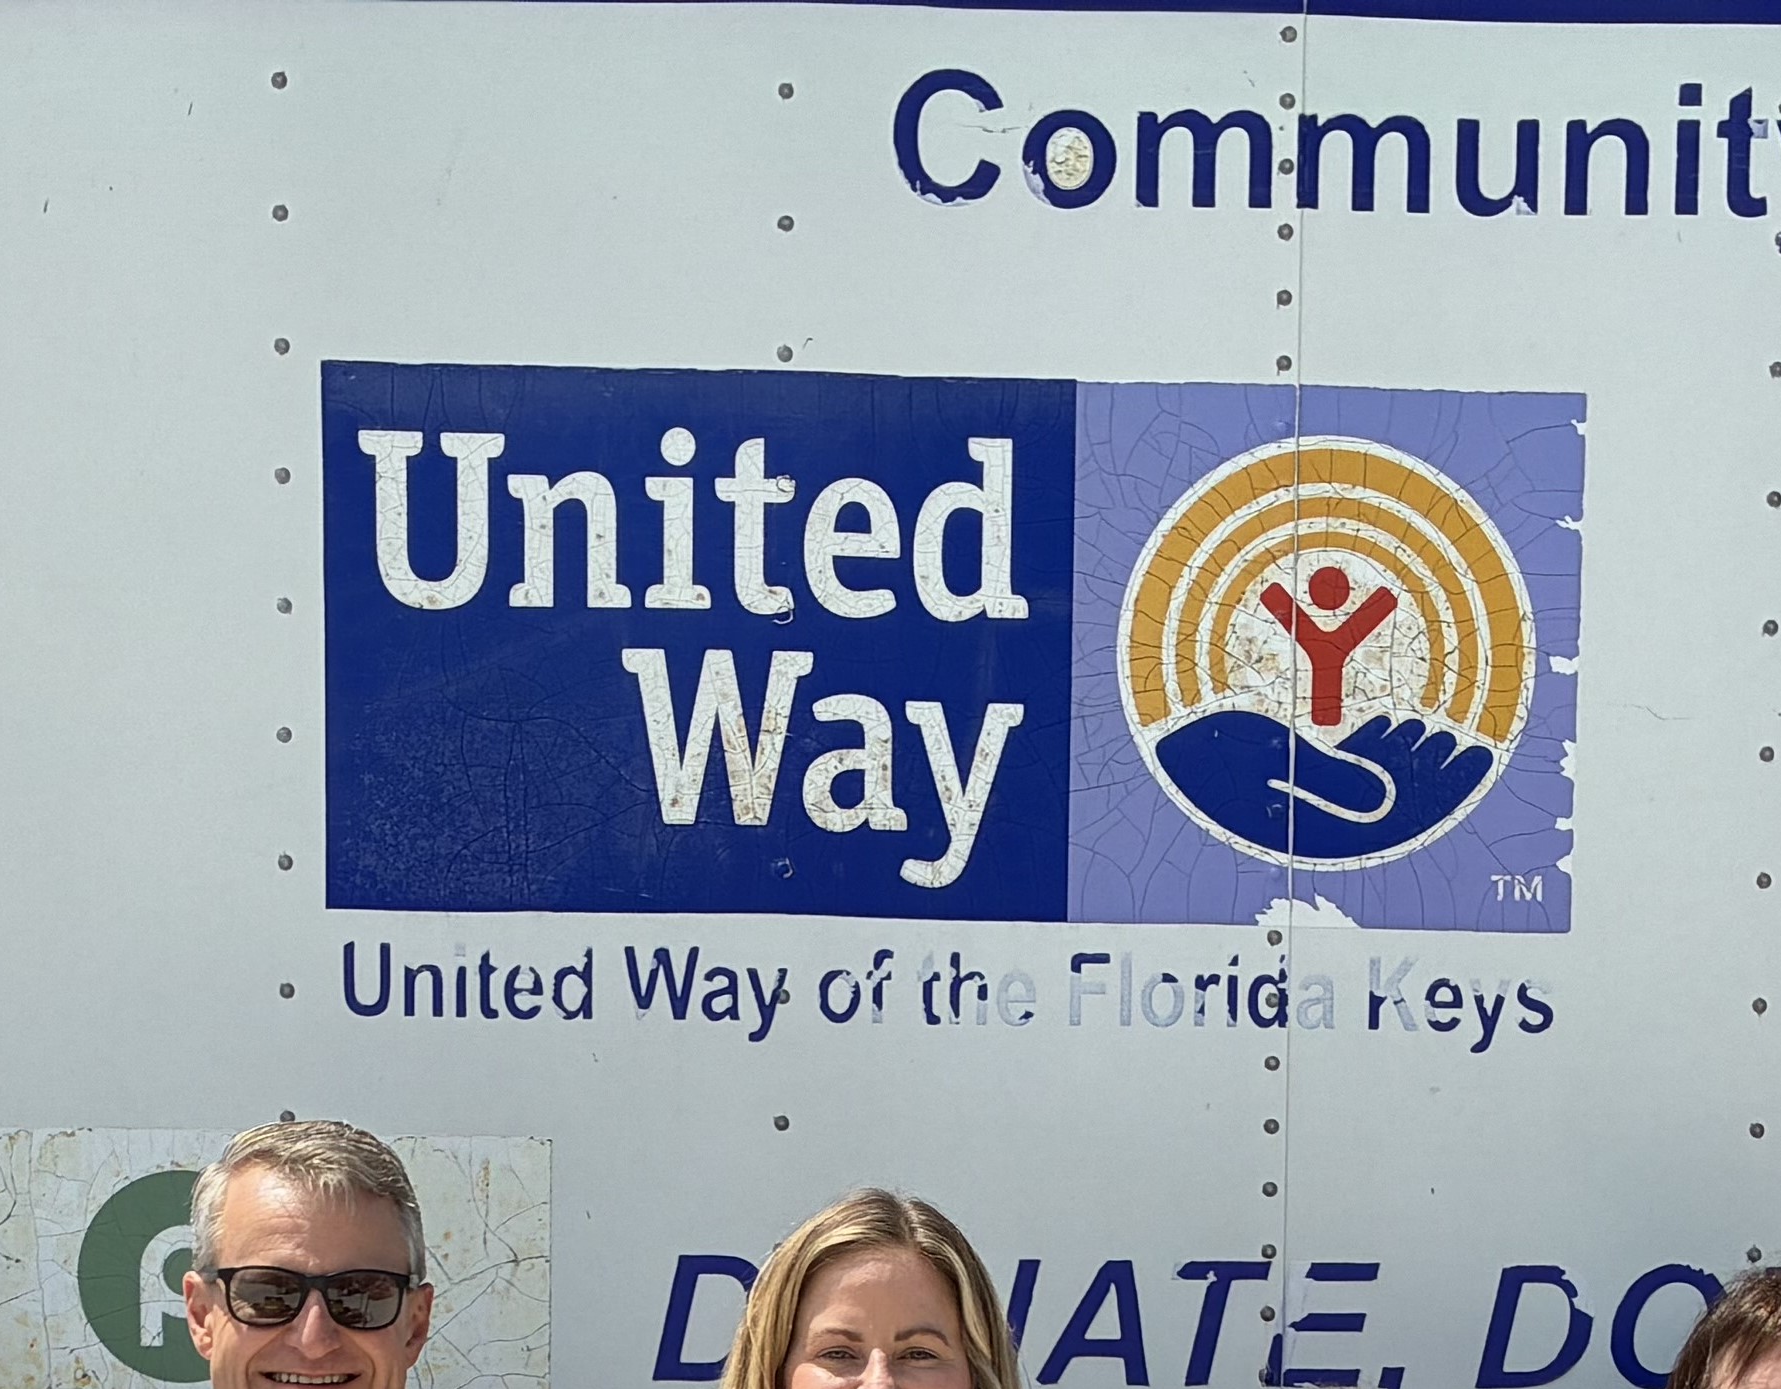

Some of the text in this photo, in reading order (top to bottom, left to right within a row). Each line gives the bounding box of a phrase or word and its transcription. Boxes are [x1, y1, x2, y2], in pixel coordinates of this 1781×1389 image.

[356, 427, 1030, 621] United
[621, 647, 1023, 889] Way
[1491, 875, 1545, 902] TM
[342, 940, 594, 1020] United
[624, 945, 789, 1042] Way
[818, 948, 894, 1025] of
[916, 950, 1037, 1027] the
[1367, 955, 1555, 1054] Keys
